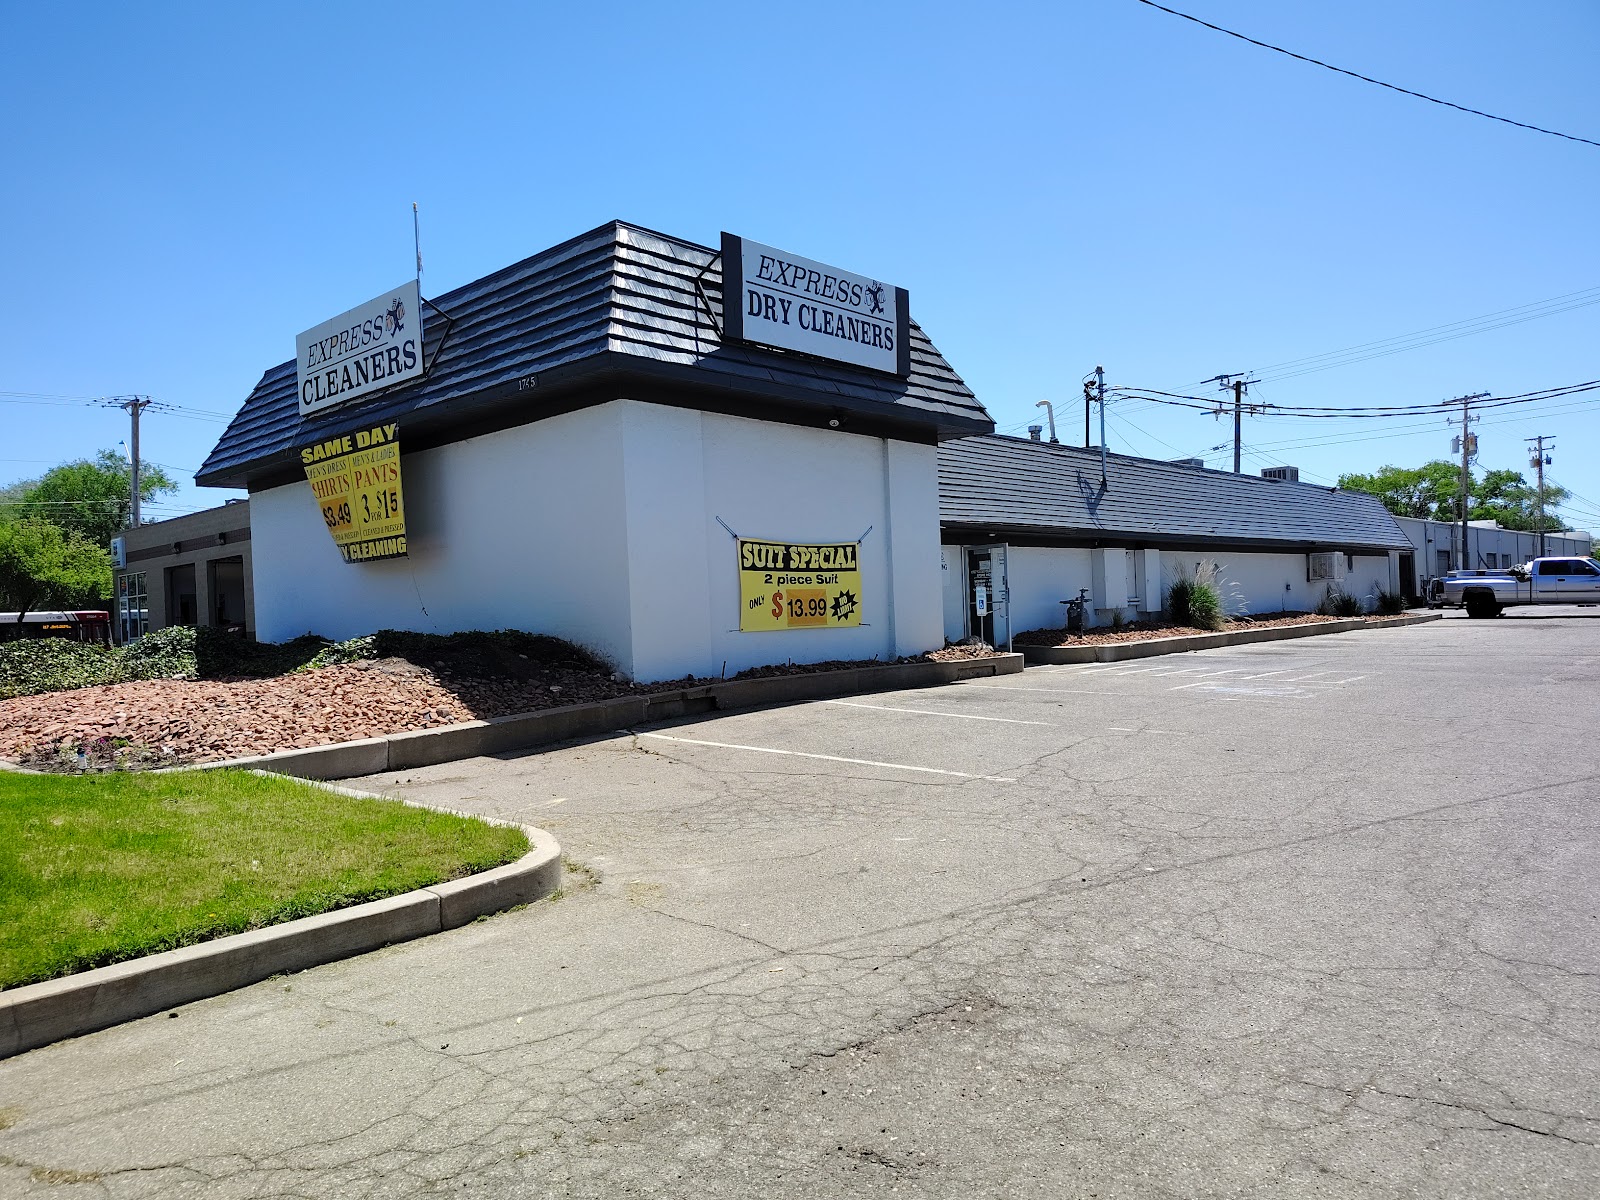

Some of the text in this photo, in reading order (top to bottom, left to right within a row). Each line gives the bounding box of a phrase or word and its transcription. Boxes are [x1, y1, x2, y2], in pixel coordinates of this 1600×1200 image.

[756, 254, 864, 307] EXPRESS
[747, 289, 894, 351] DRY CLEANERS
[307, 314, 384, 369] EXPRESS
[302, 339, 417, 406] CLEANERS
[301, 422, 397, 464] SAME DAY
[327, 460, 347, 475] DRESS
[354, 462, 398, 489] PANTS
[312, 474, 350, 499] SHIRTS
[322, 502, 352, 528] $3.49
[361, 493, 371, 524] 3
[350, 537, 407, 559] CLEANING
[742, 543, 856, 569] SUIT SPECIAL
[764, 574, 839, 587] 2 piece Suit
[749, 594, 765, 610] ONLY
